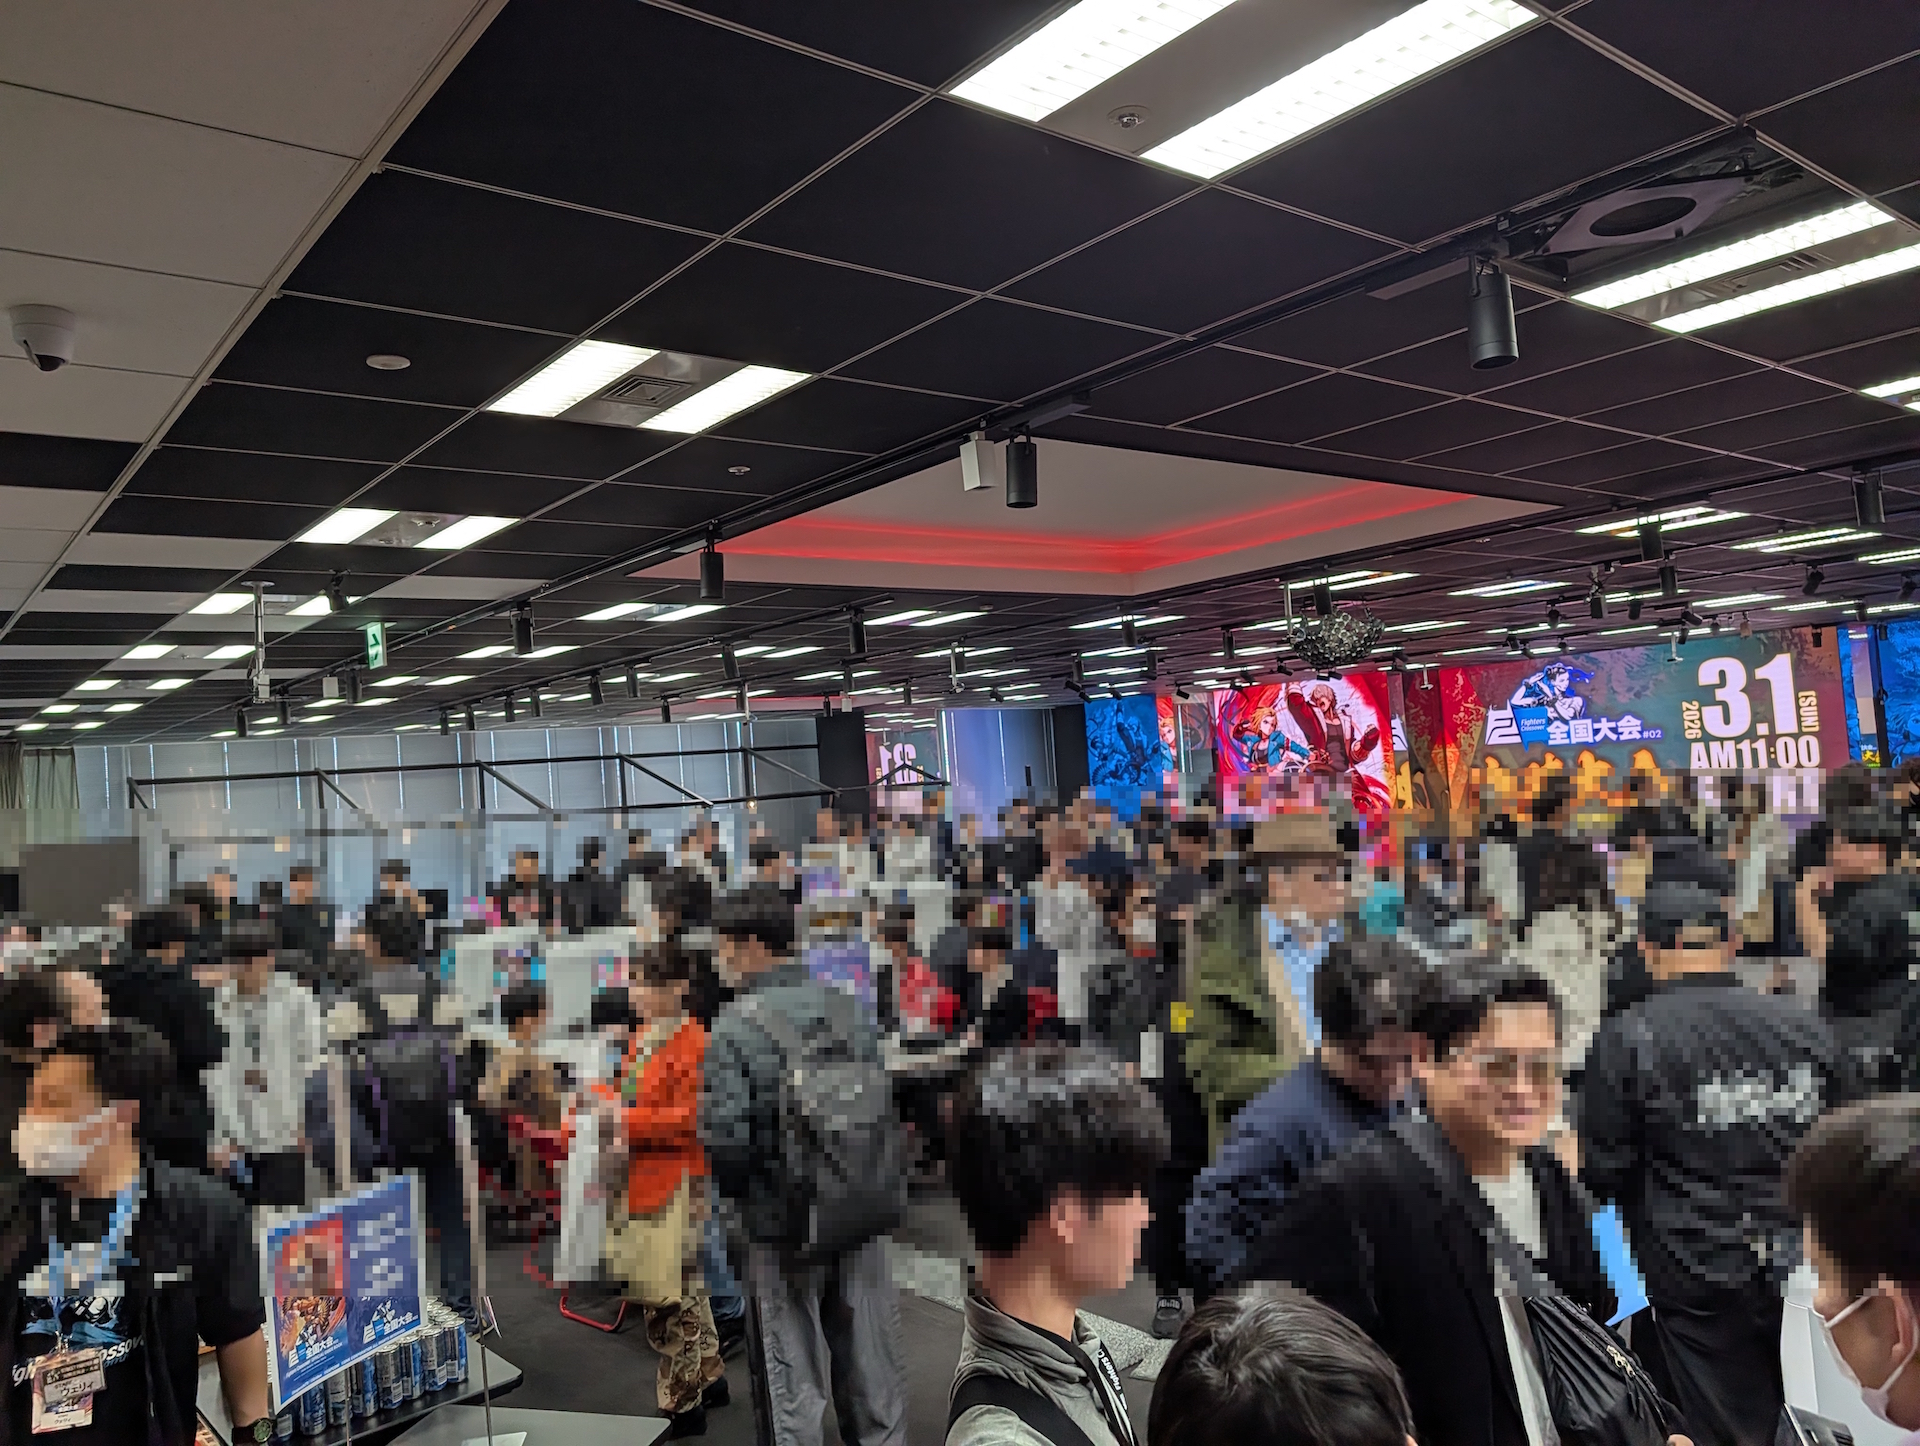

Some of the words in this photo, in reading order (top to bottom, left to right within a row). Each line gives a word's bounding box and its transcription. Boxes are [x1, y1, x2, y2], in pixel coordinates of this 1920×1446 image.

[1698, 653, 1799, 738] 3.1
[1521, 718, 1546, 727] Fighters
[1547, 715, 1642, 745] 全国大会
[1643, 730, 1662, 739] #02
[1682, 701, 1702, 739] 2026
[306, 1336, 334, 1359] 全国大会
[1101, 1357, 1121, 1390] Fighters
